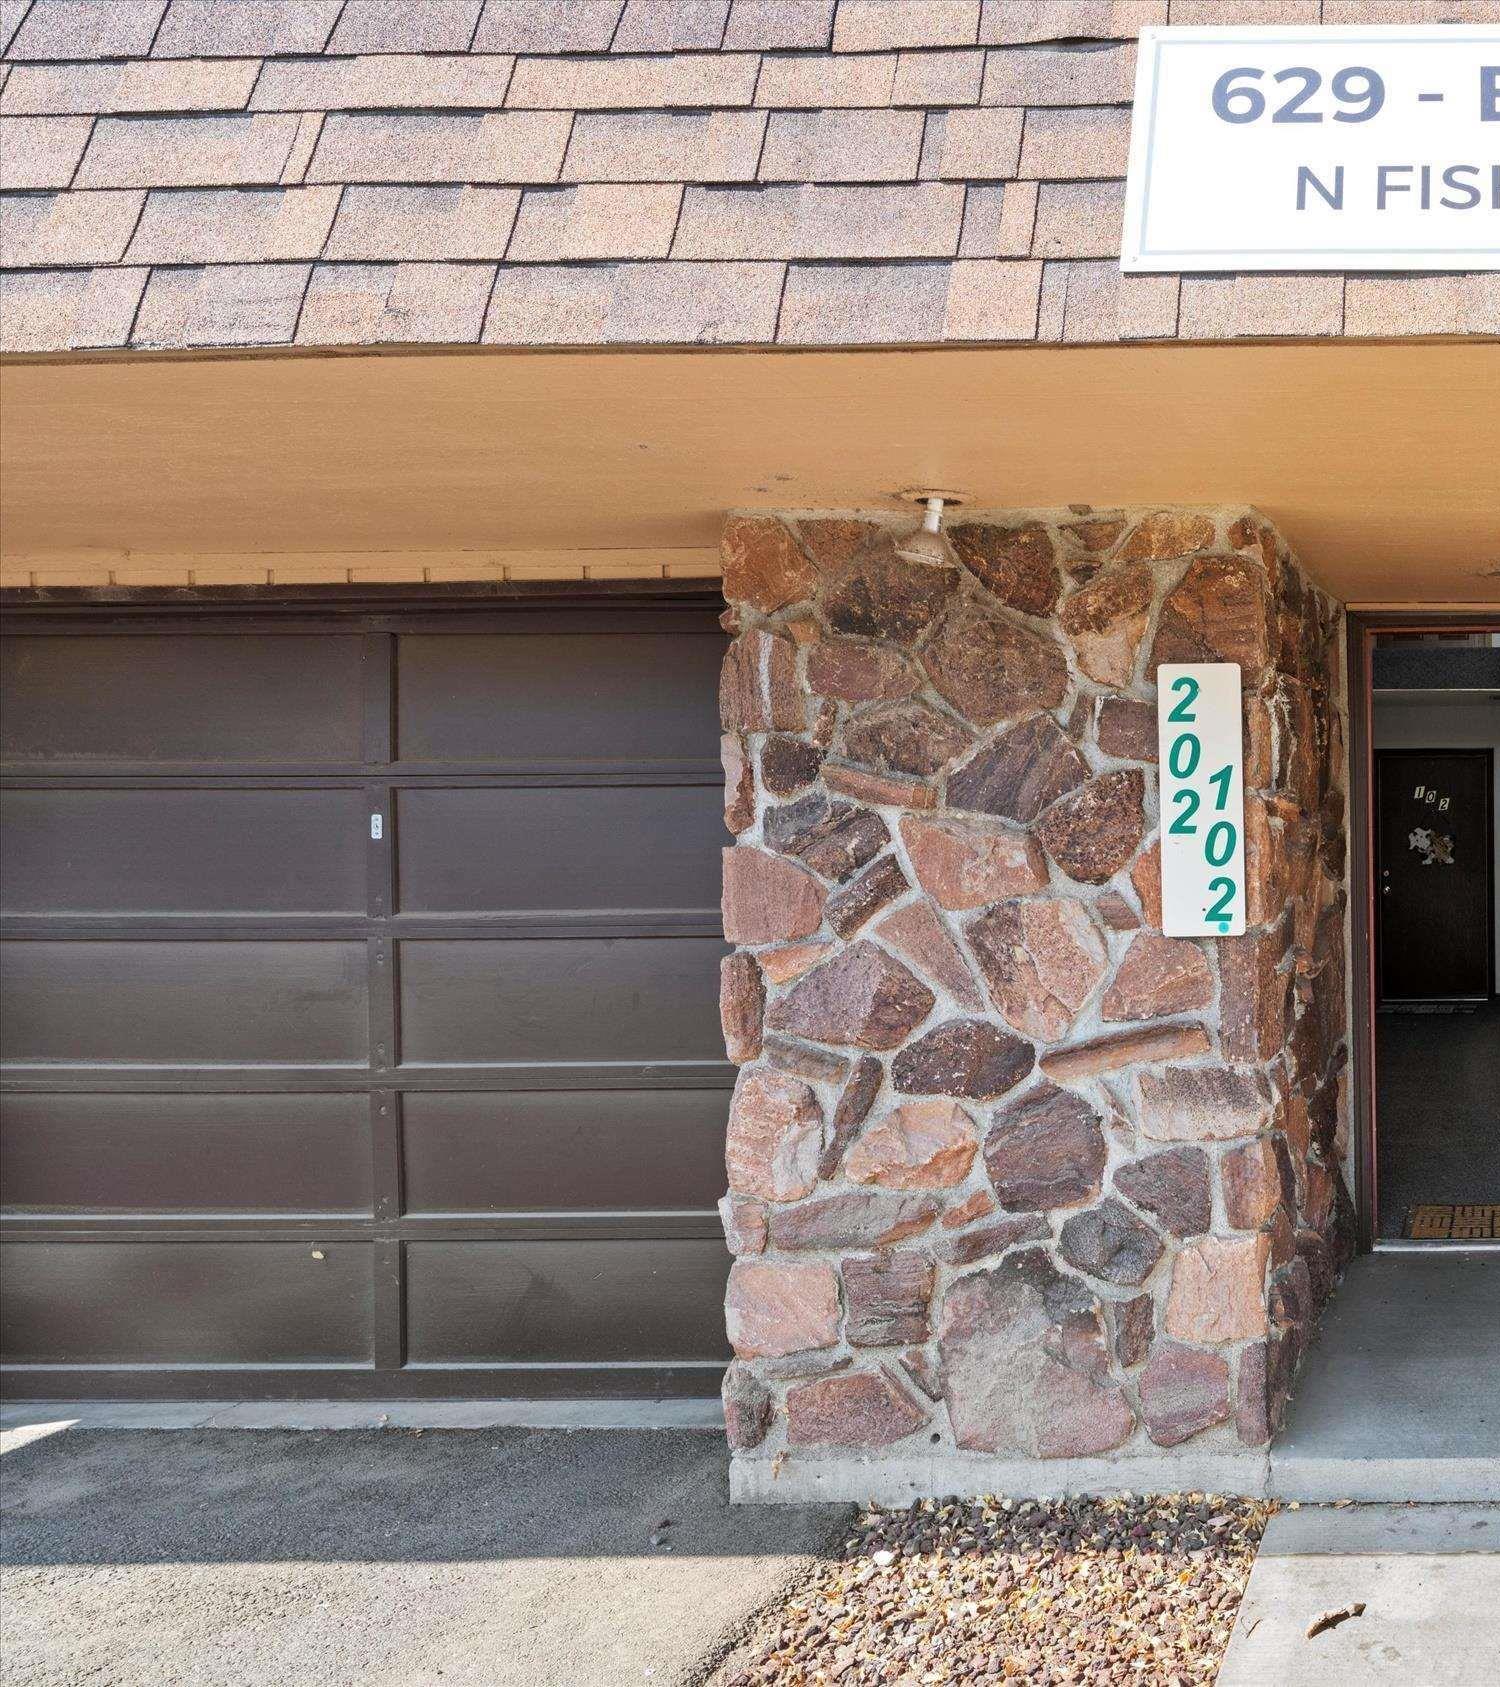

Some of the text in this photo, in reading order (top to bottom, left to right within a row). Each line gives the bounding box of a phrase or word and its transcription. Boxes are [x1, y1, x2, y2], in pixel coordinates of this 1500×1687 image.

[1211, 66, 1386, 125] 629
[1295, 165, 1344, 211] N
[1167, 676, 1201, 835] 202
[1204, 764, 1237, 922] 102
